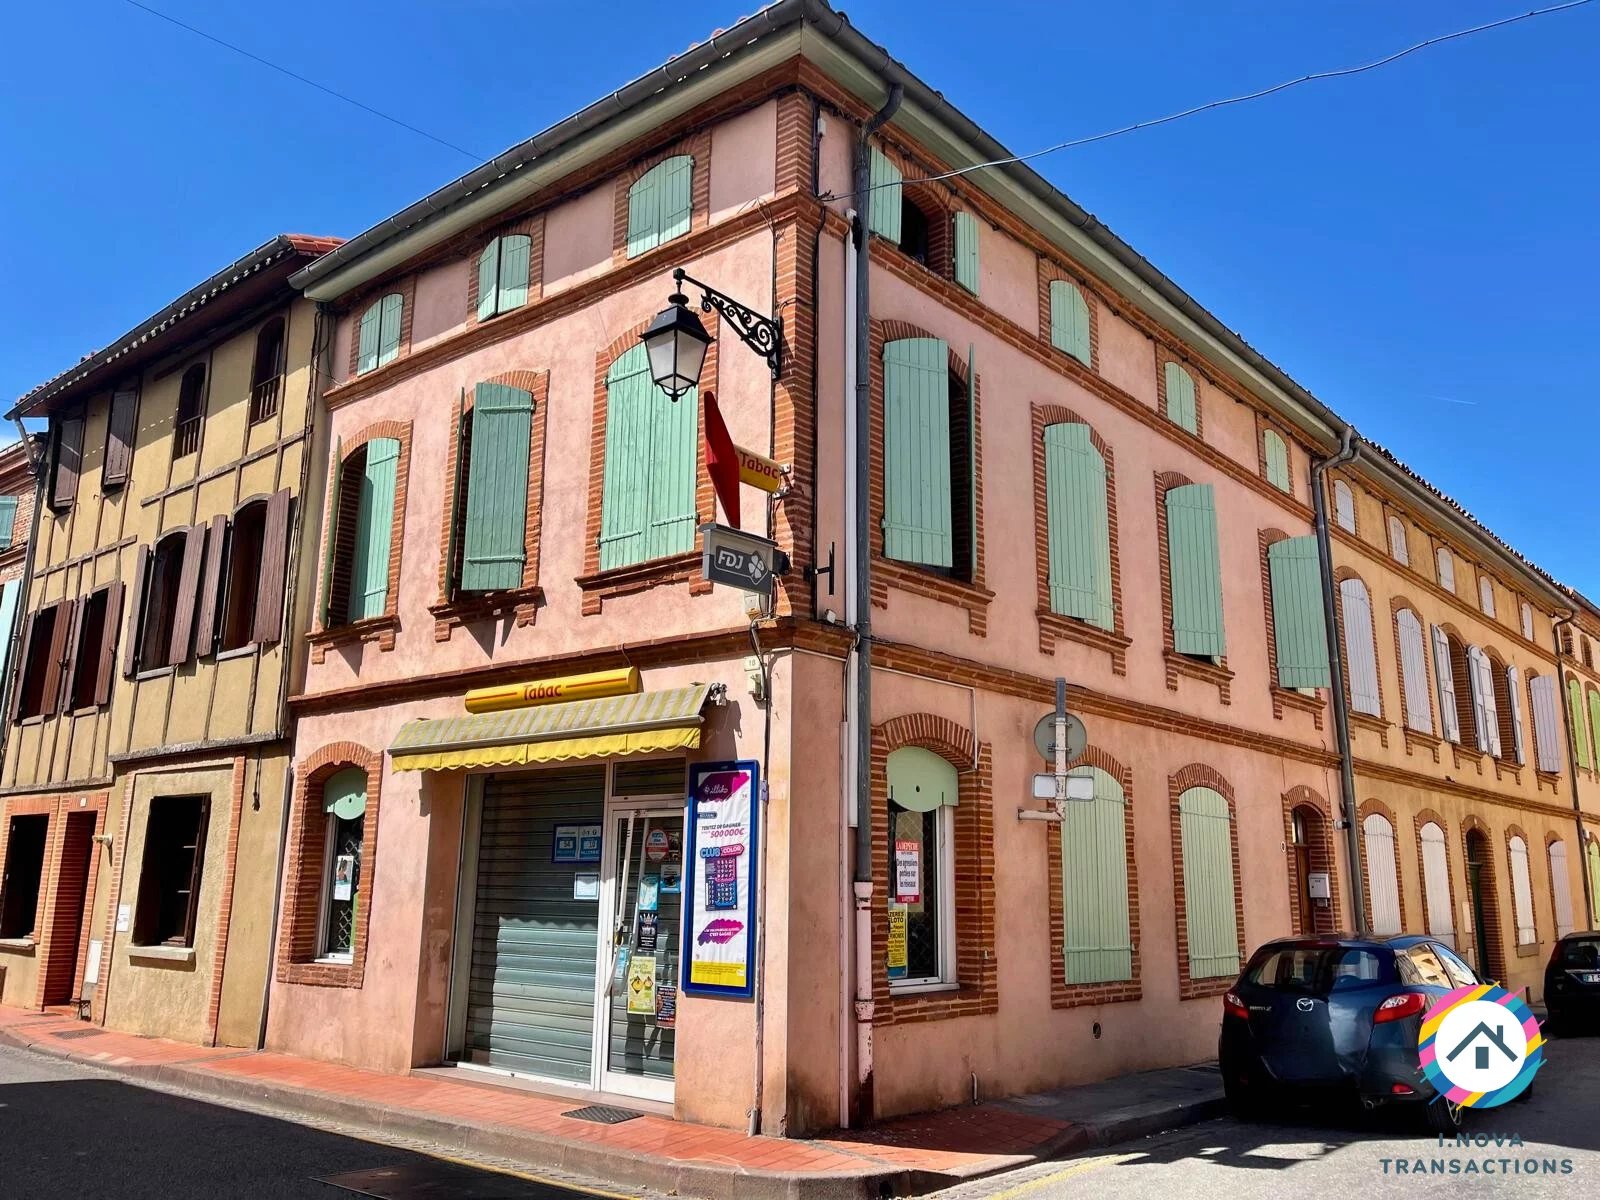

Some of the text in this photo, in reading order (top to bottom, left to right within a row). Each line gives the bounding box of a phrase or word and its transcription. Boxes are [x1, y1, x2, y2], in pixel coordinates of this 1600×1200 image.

[740, 450, 779, 480] Tabac
[718, 550, 744, 570] FDJ
[522, 683, 562, 701] Tabac
